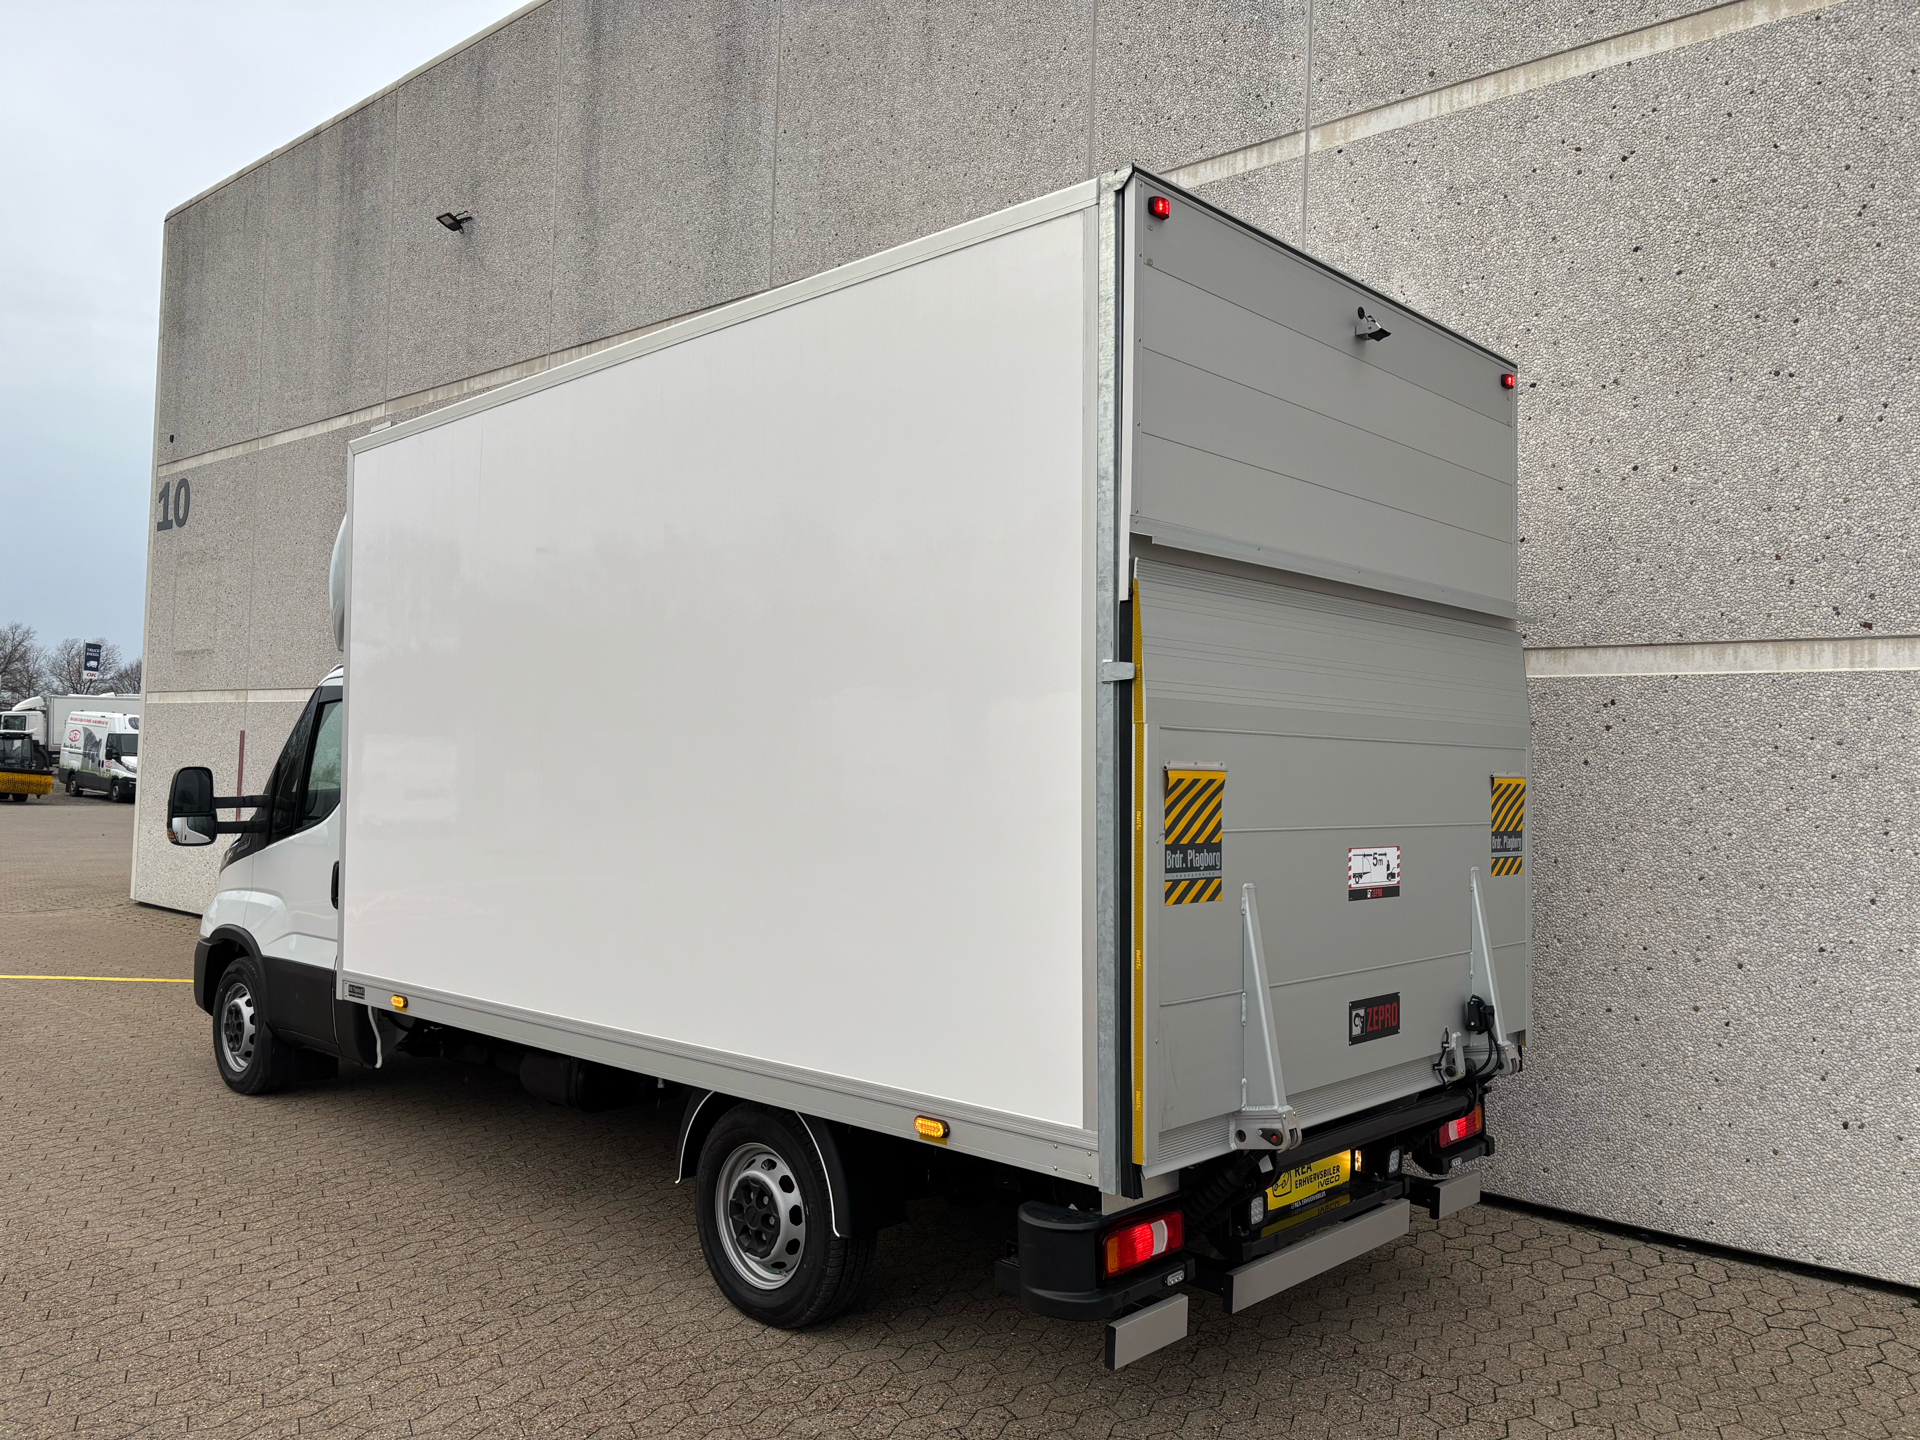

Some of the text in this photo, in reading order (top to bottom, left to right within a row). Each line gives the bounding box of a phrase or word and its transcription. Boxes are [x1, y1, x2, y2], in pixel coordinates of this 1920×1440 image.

[157, 478, 190, 531] 10
[1166, 849, 1220, 870] Brdr. Plagborg
[1366, 1002, 1398, 1032] ZEPRO
[1295, 1164, 1340, 1189] ERHVERVSBILER
[1317, 1174, 1340, 1189] IVECO
